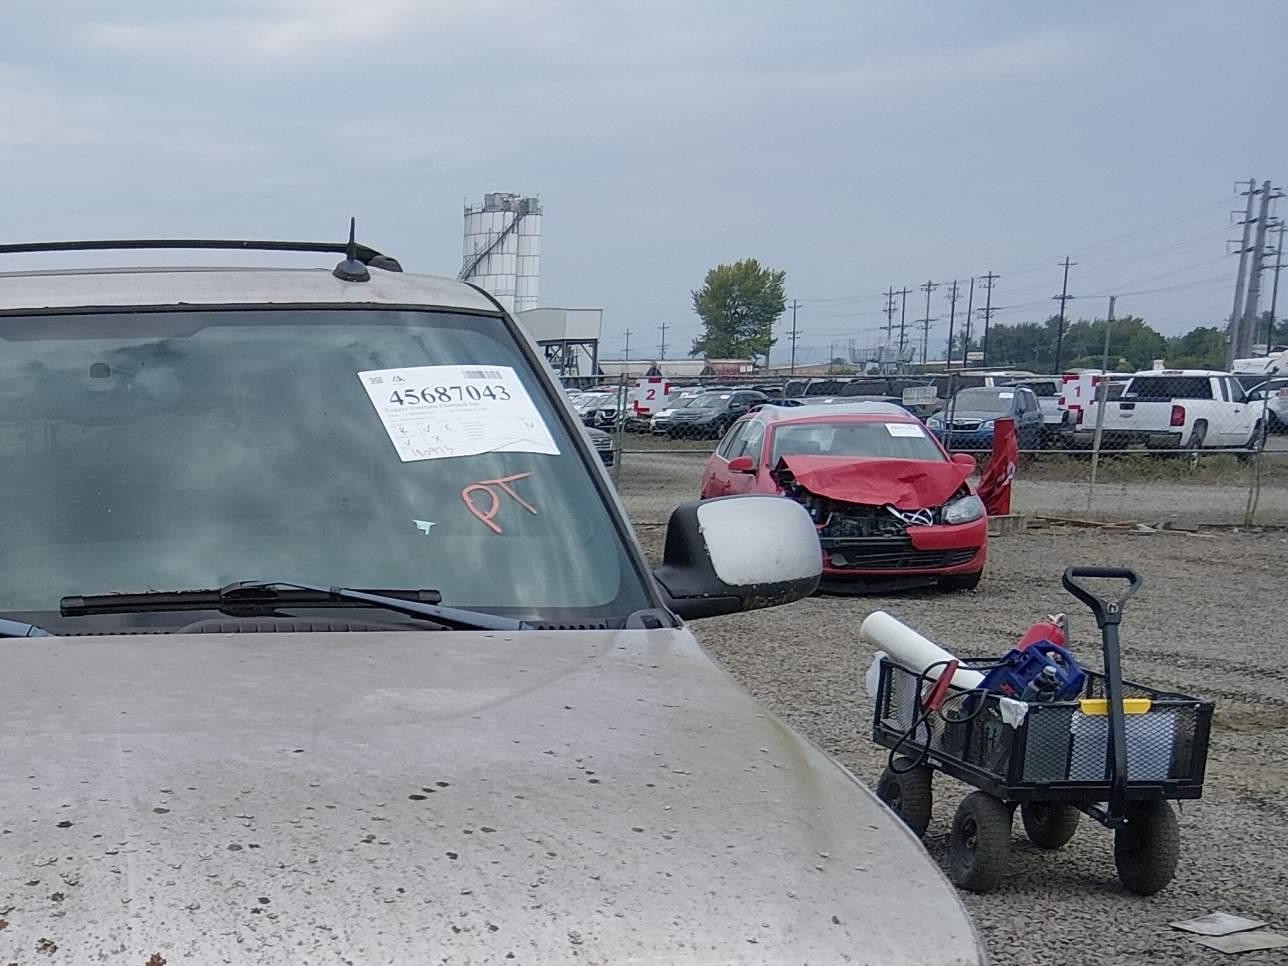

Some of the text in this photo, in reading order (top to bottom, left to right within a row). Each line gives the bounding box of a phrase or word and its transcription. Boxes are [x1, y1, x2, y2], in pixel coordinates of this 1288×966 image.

[389, 384, 511, 406] 45687043
[646, 389, 655, 400] 2
[1074, 386, 1081, 397] 1
